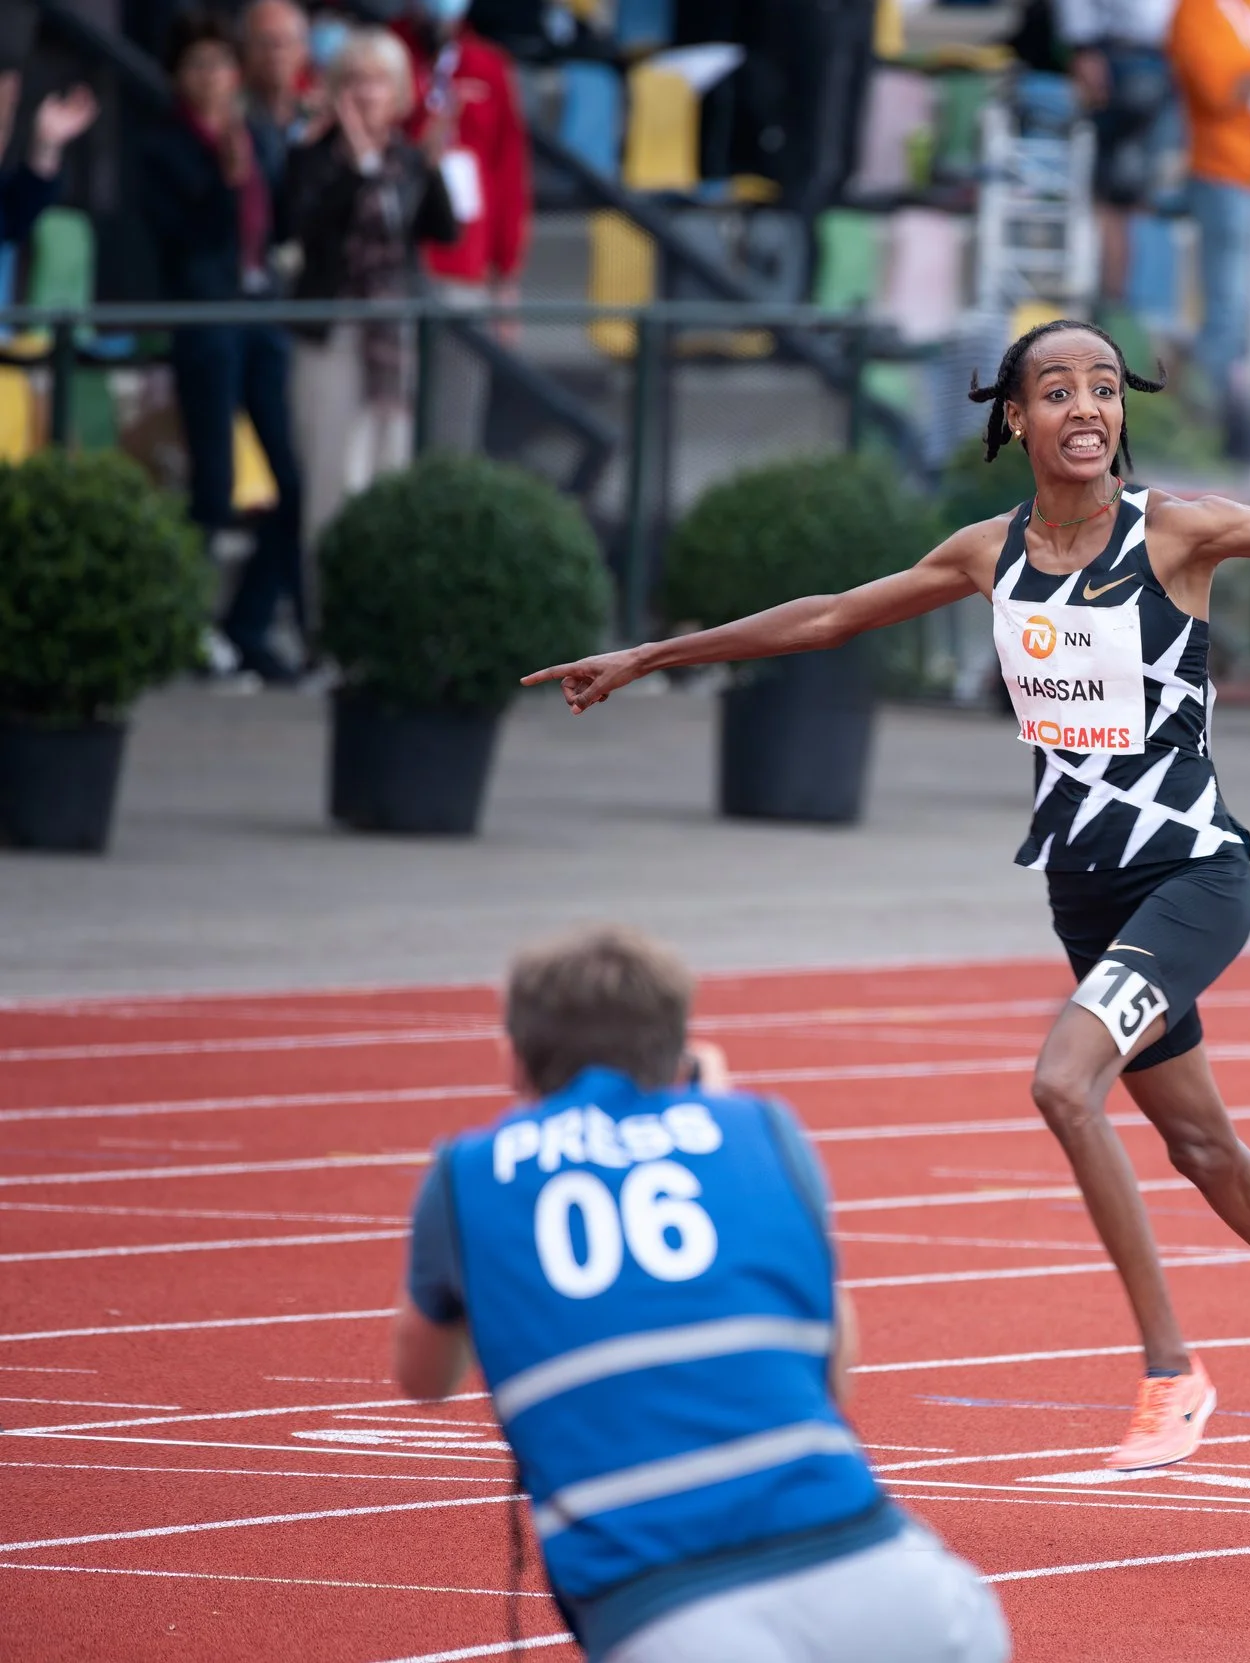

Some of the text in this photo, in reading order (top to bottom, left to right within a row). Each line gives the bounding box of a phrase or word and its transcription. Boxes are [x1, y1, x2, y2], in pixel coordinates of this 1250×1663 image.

[1064, 631, 1091, 647] NN
[1017, 675, 1104, 701] HASSAN
[1099, 965, 1159, 1037] 15
[493, 1103, 723, 1184] PRESS
[533, 1158, 718, 1300] 06
